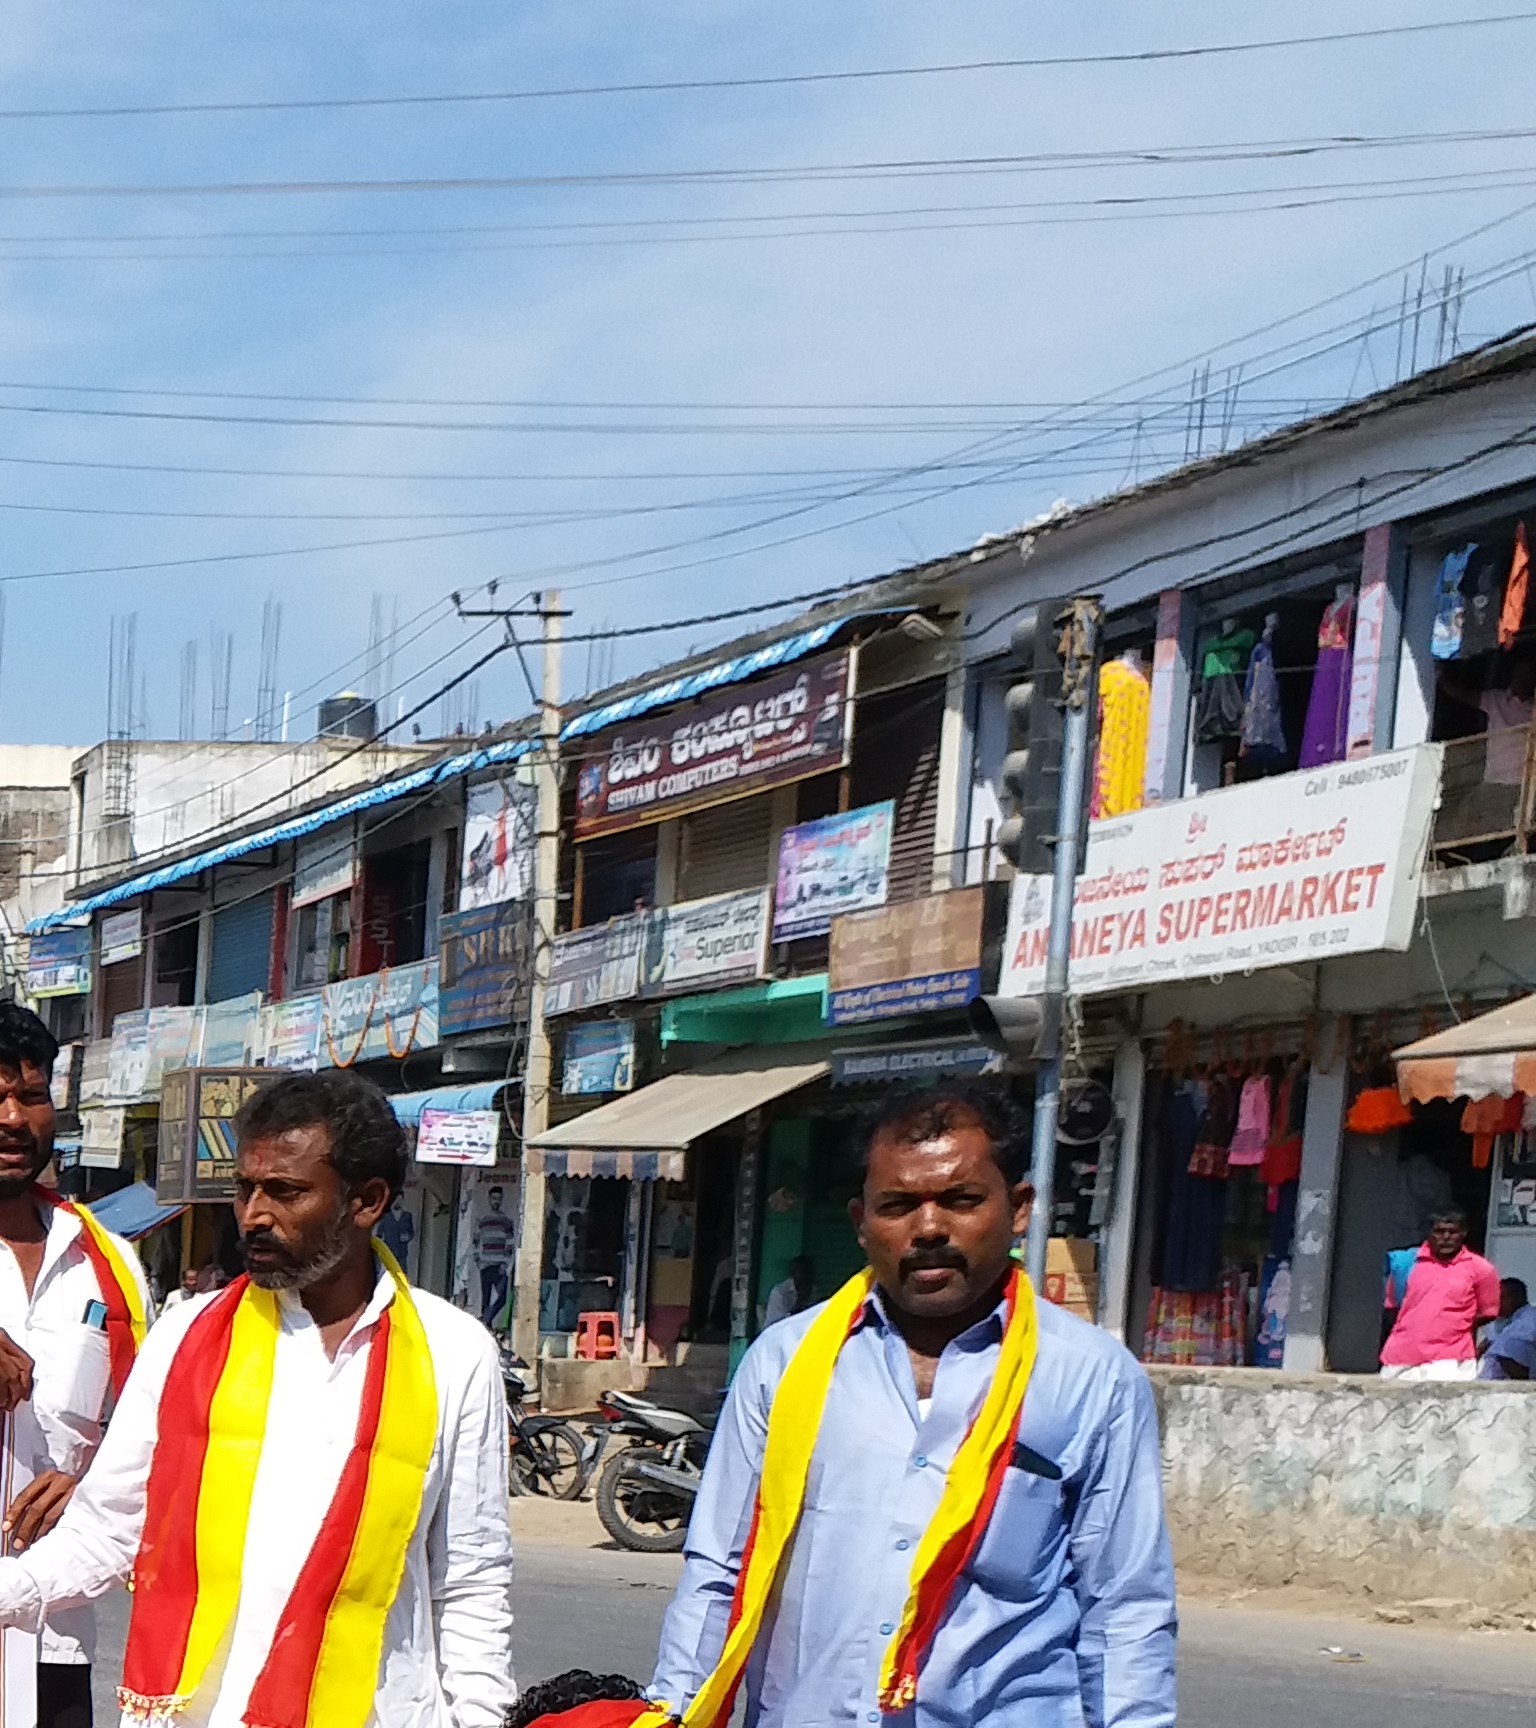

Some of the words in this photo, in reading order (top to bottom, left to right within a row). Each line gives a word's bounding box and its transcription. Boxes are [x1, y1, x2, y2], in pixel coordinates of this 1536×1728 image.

[1011, 908, 1147, 970] ANANEYA
[1155, 862, 1386, 945] SUPERMARKET
[694, 931, 758, 964] Superior
[477, 1170, 517, 1183] Jeans
